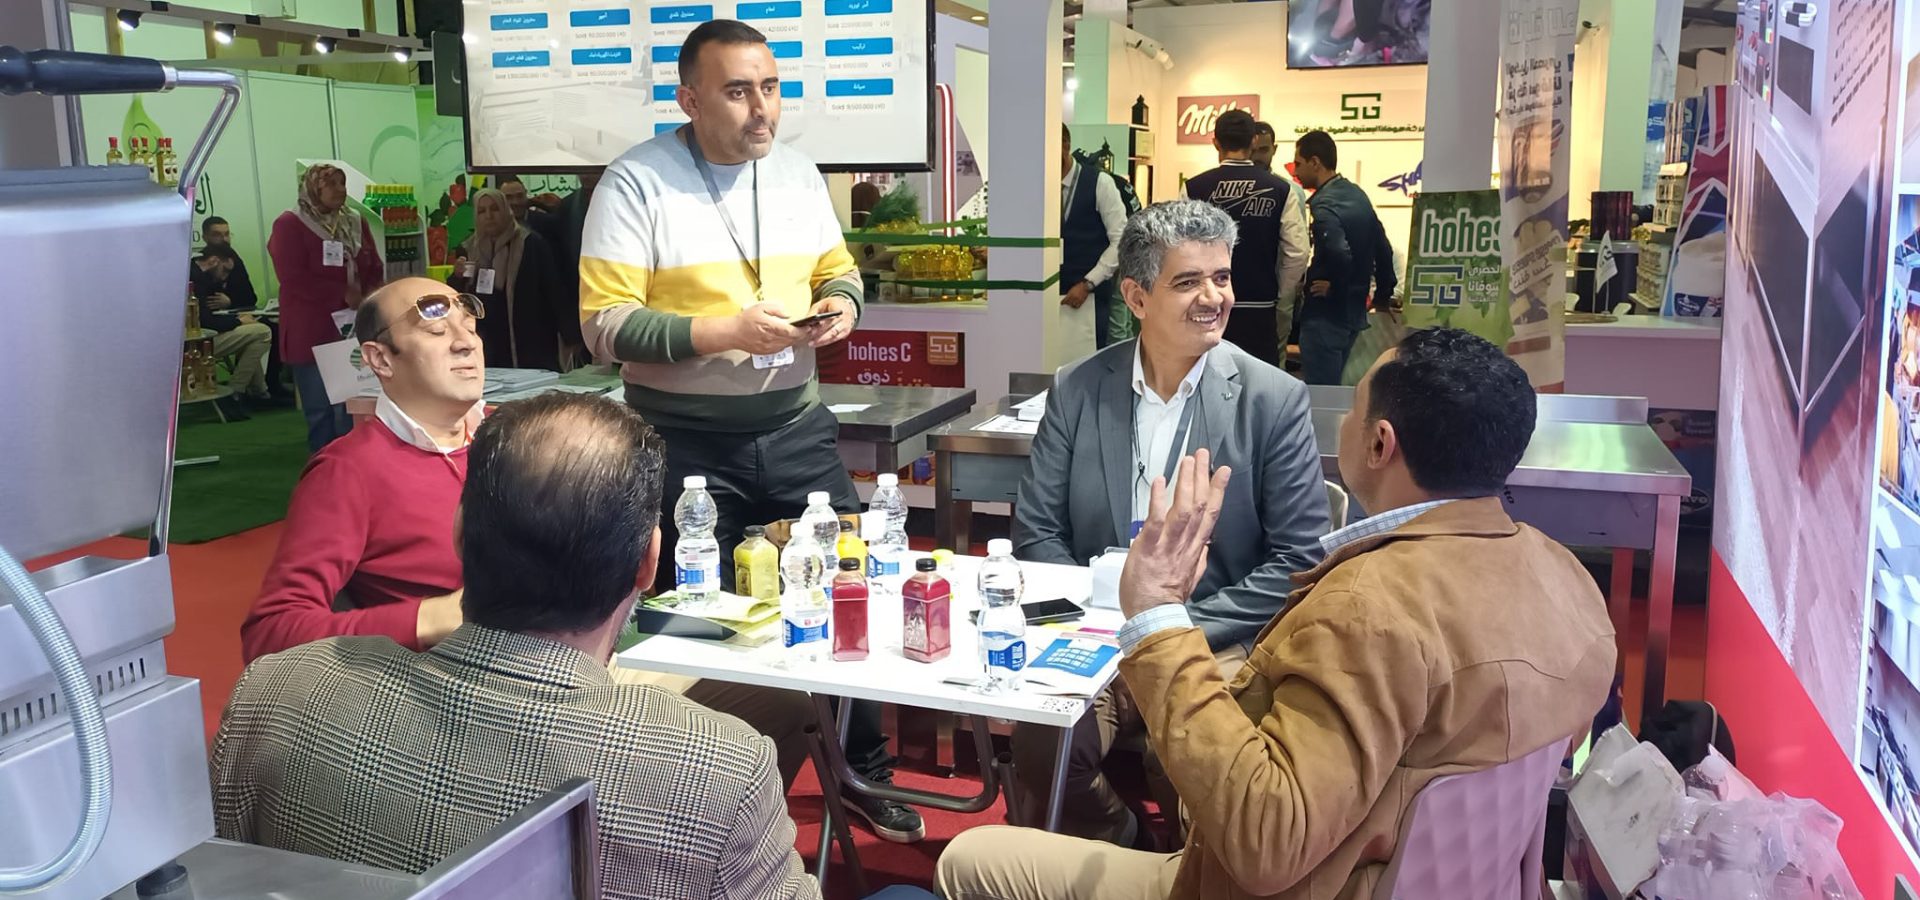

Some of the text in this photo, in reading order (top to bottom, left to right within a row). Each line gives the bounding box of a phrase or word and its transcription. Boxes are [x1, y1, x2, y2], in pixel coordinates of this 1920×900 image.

[1212, 180, 1257, 199] NIKE
[1241, 196, 1276, 217] AIR
[848, 341, 912, 362] hohes C
